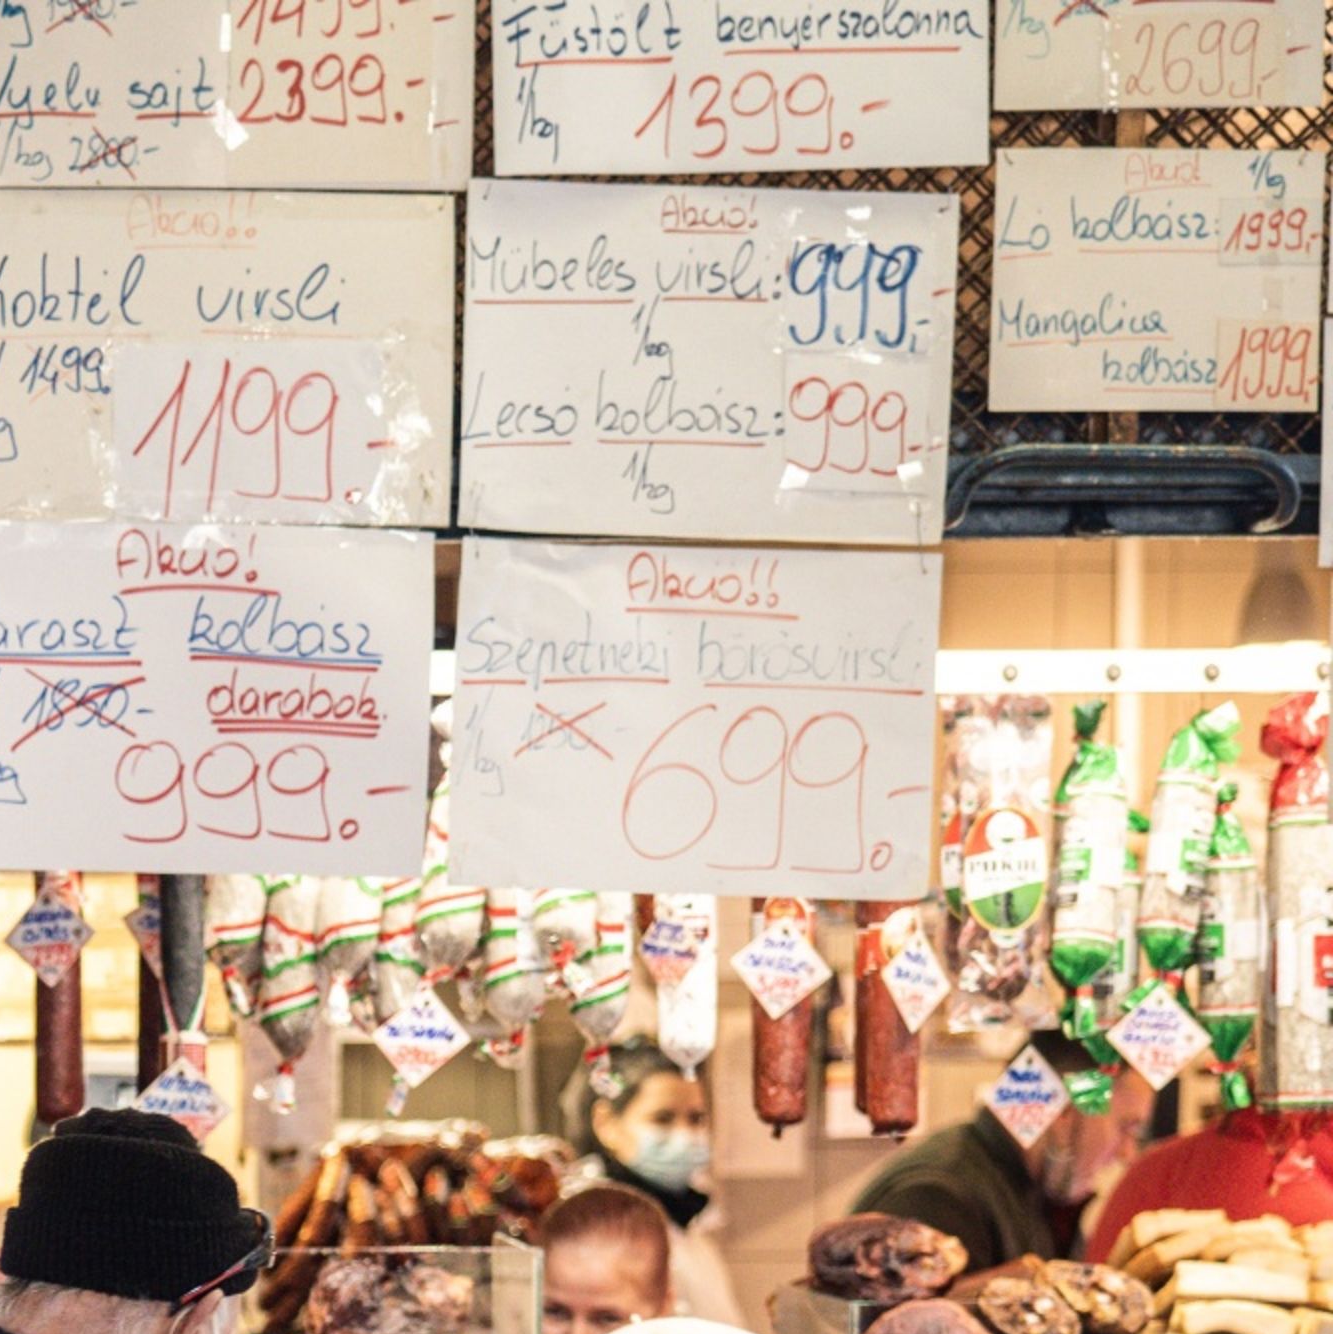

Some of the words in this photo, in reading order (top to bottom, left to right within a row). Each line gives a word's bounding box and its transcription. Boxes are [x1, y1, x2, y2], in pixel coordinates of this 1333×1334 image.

[128, 56, 214, 128] sajt
[634, 71, 891, 159] 1399.-
[195, 262, 346, 327] virsli
[114, 740, 413, 844] 999.-
[622, 703, 930, 875] 699.-
